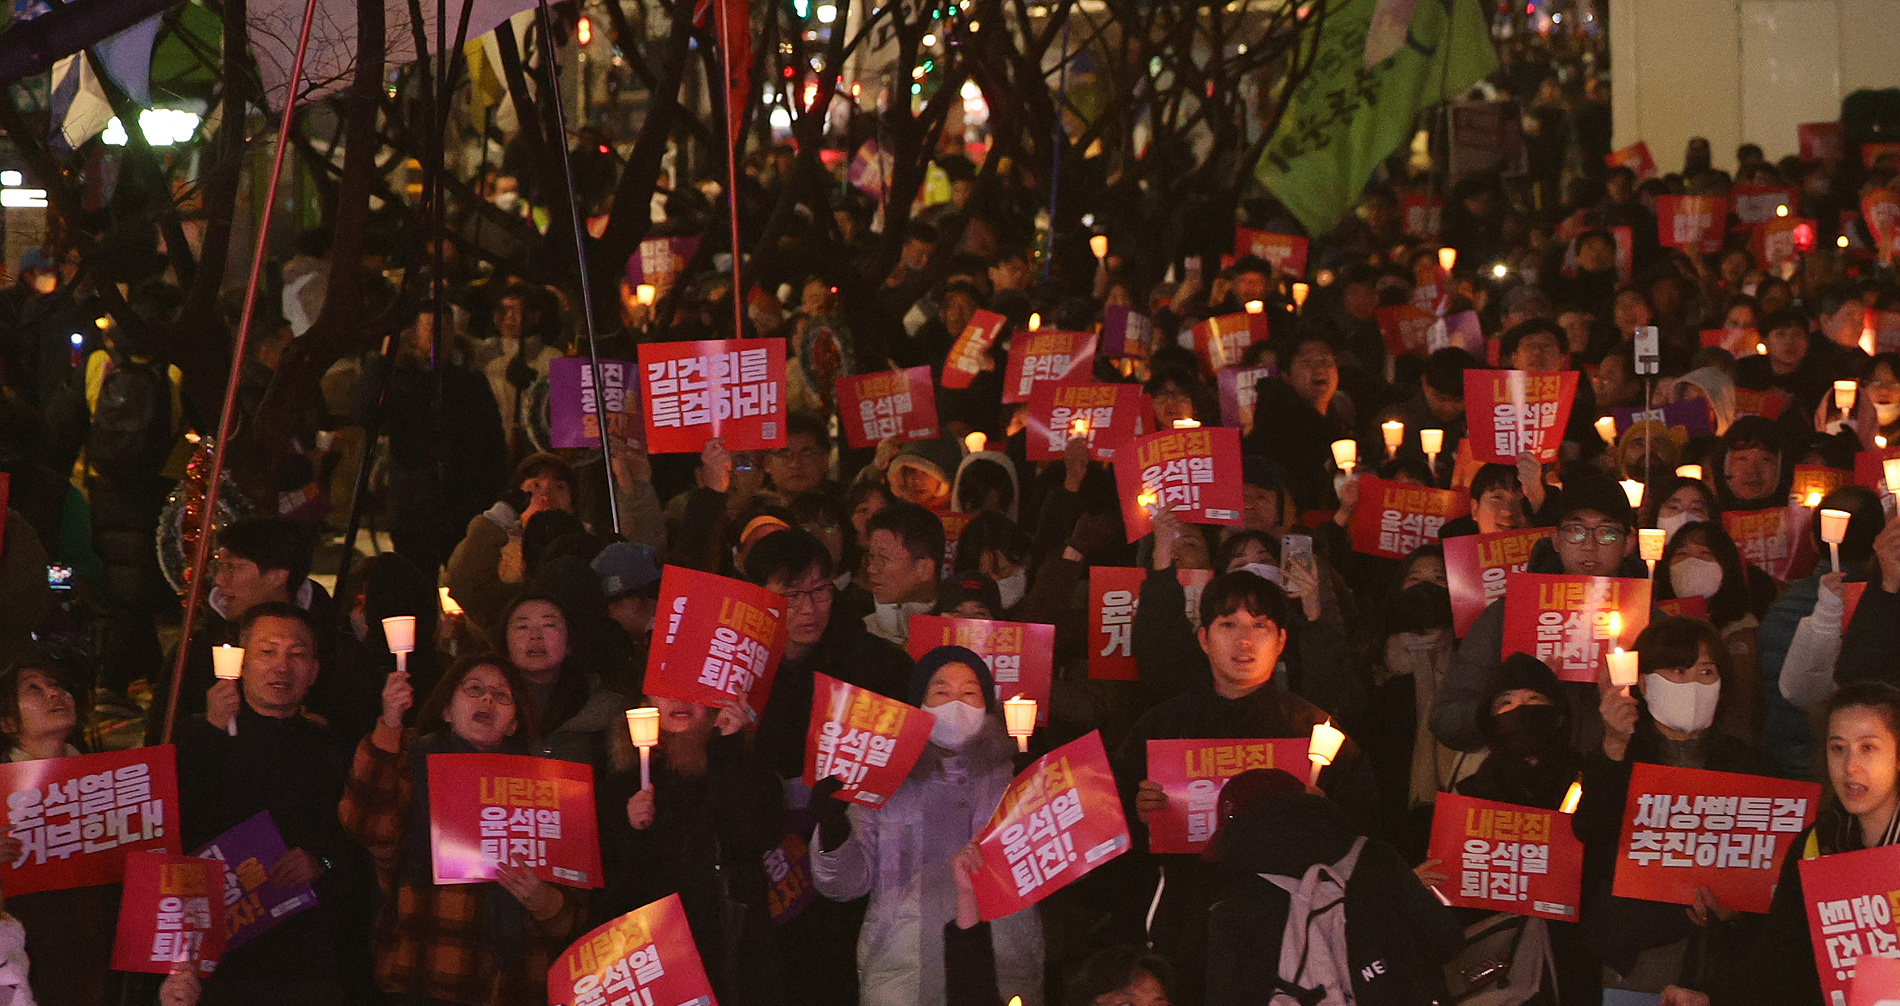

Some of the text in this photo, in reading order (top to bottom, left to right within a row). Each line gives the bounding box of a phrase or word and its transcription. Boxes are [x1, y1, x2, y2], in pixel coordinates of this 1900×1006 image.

[648, 348, 768, 395] 김건희를
[855, 374, 912, 399] 내란죄
[1493, 376, 1561, 402] 내란죄
[651, 382, 778, 428] 특검하라!
[859, 393, 913, 421] 윤석열
[1055, 386, 1118, 408] 내란죄
[862, 416, 903, 441] 퇴진!
[1051, 407, 1114, 430] 윤석열
[1494, 402, 1558, 429] 윤석열
[1138, 432, 1212, 468] 내란죄
[1141, 458, 1213, 489] 윤석열
[1384, 488, 1449, 516] 내란죄
[1381, 510, 1446, 538] 윤석열
[1539, 582, 1620, 611] 내란죄
[943, 626, 1023, 655] 내란죄
[1537, 611, 1611, 641] 윤석열
[711, 627, 770, 682] 윤석열
[826, 685, 908, 735] 내란죄
[816, 721, 897, 768] 윤석열
[1186, 744, 1274, 779] 내란죄
[815, 754, 868, 790] 퇴진!
[1006, 758, 1074, 816] 내란죄
[7, 763, 151, 831] 윤석열을
[479, 775, 561, 808] 내란죄
[478, 806, 561, 840] 윤석열
[1000, 786, 1086, 866] 윤석열
[1465, 807, 1550, 845] 내란죄
[1631, 791, 1809, 834] 채상병특검
[11, 799, 164, 869] 거부한다!
[1628, 826, 1774, 872] 추진하라!
[479, 838, 548, 869] 퇴진!
[1012, 842, 1078, 897] 퇴진!
[1461, 840, 1549, 876] 윤석열
[1460, 871, 1530, 904] 퇴진!
[1818, 899, 1858, 982] 퇴진!
[1851, 894, 1900, 962] 윤석
[569, 918, 653, 980] 내란죄
